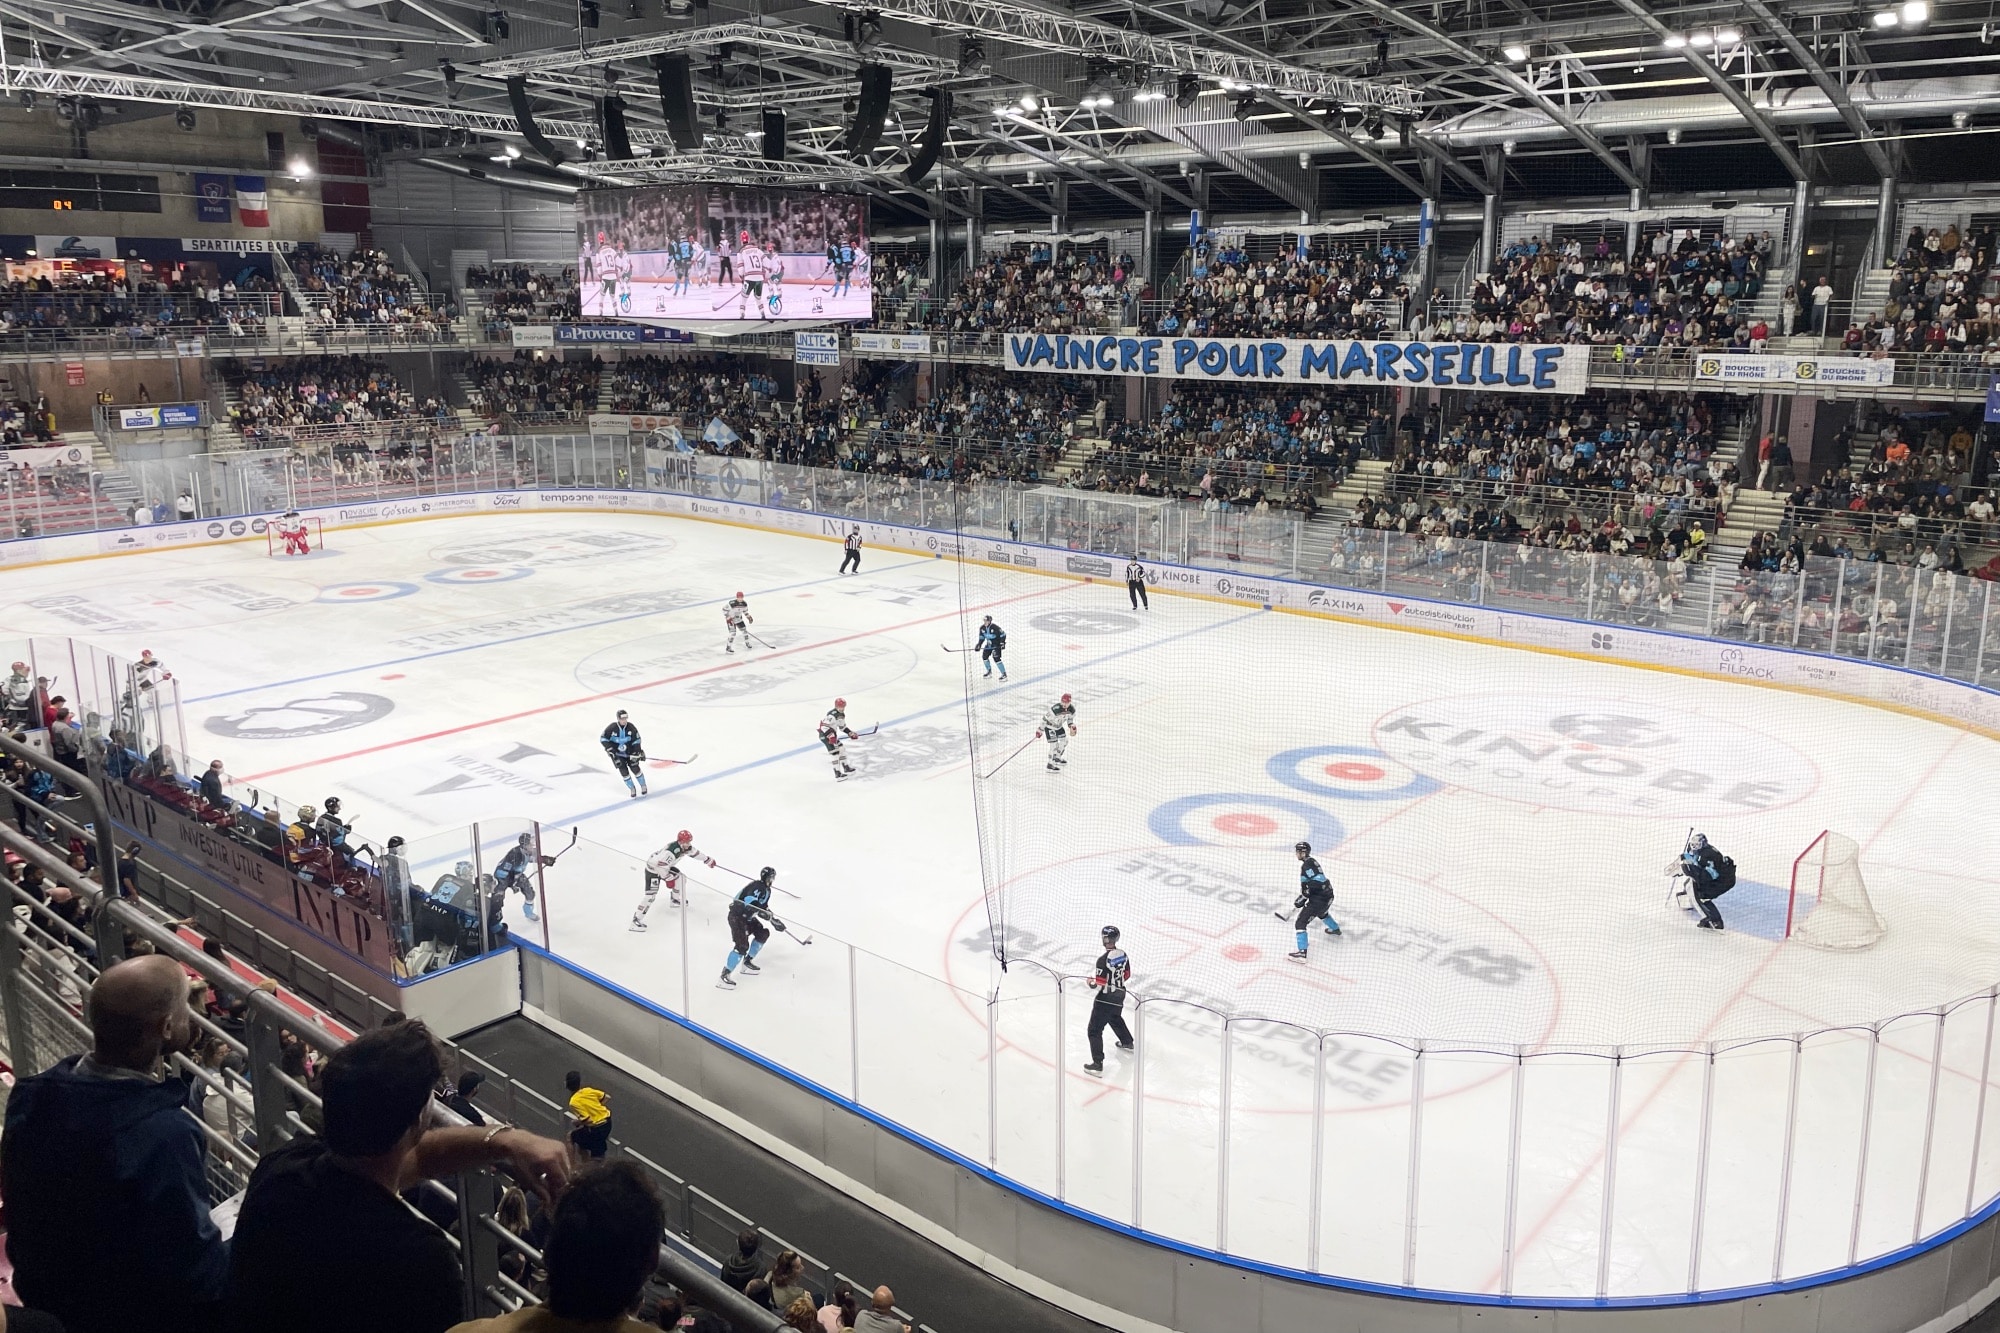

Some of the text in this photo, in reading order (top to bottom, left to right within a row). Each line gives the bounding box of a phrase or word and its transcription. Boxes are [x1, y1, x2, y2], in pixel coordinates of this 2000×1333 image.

[53, 200, 72, 210] 04
[191, 240, 290, 252] SPARTIATES BAR
[749, 255, 761, 268] 13
[796, 352, 839, 364] SPARTIATE
[1011, 334, 1564, 390] VAINCRE POUR MARSEILLE
[493, 494, 521, 505] Ford
[1162, 570, 1201, 585] KINOBE
[1235, 585, 1270, 595] BOUCHES
[1235, 591, 1245, 599] DU
[1322, 598, 1365, 612] AXIMA
[1404, 607, 1475, 623] autodistribution
[1719, 662, 1774, 680] FILPACK
[1379, 714, 1784, 809] KINOBE
[445, 754, 554, 795] VILTIFRUITS
[179, 823, 230, 865] INVESTIR
[232, 851, 265, 884] UTILE
